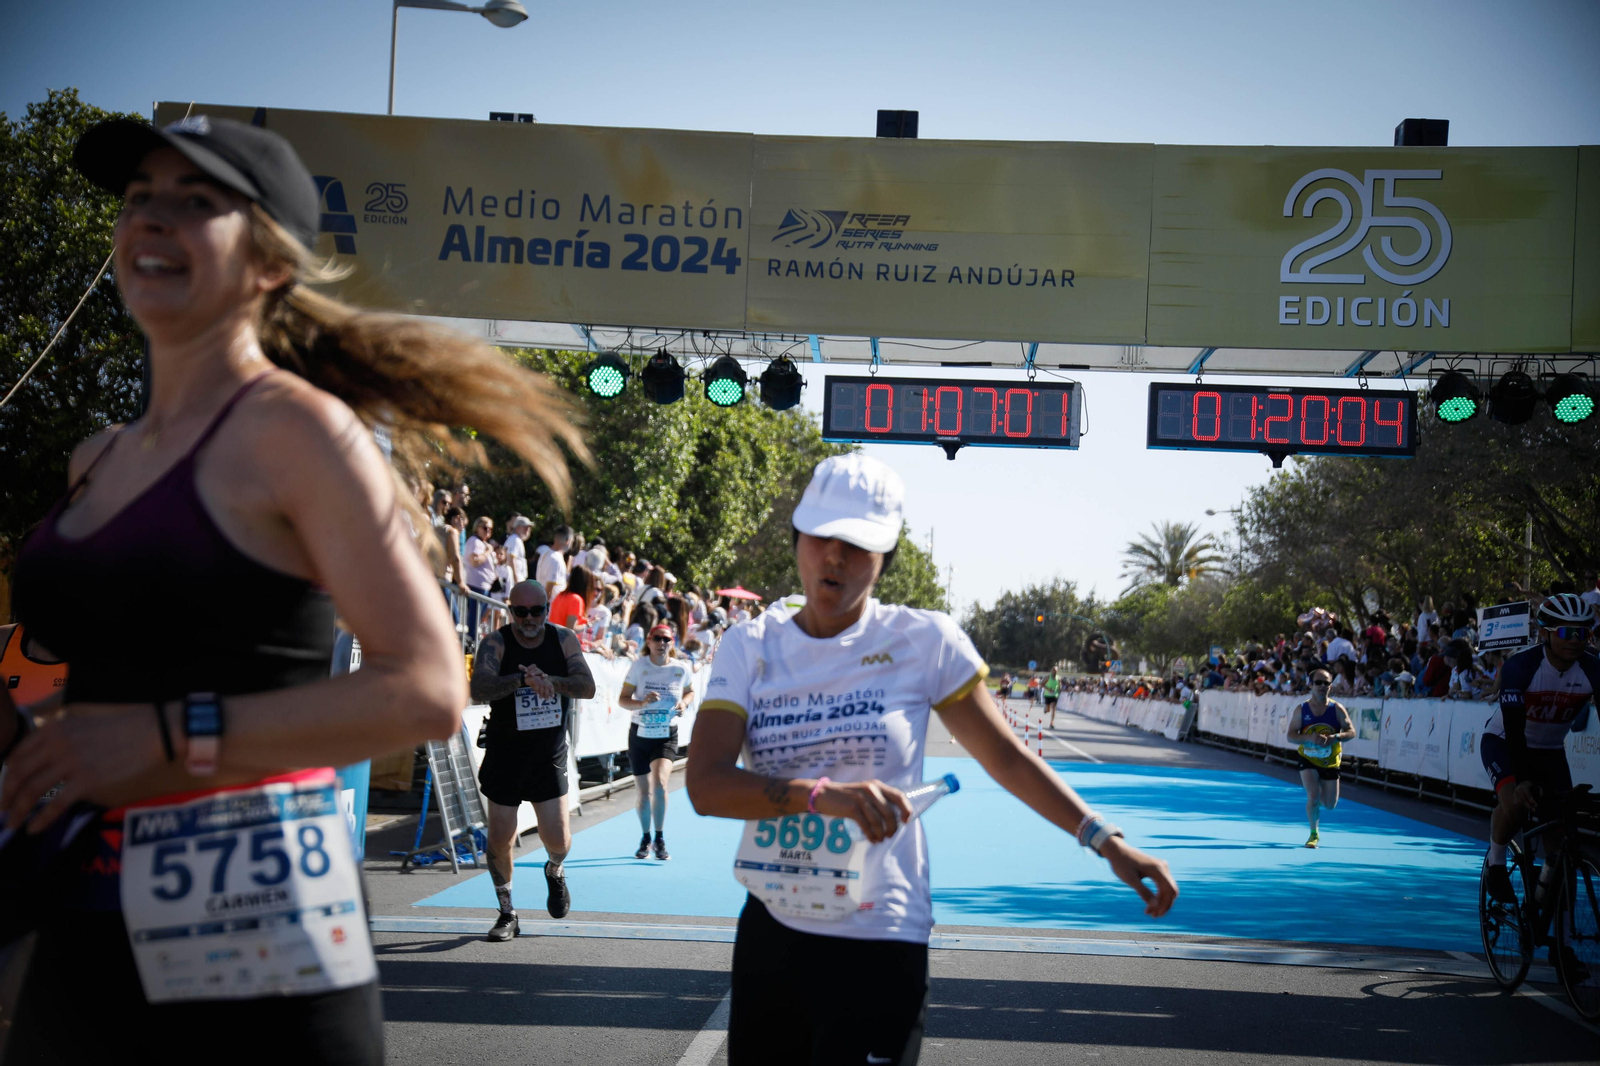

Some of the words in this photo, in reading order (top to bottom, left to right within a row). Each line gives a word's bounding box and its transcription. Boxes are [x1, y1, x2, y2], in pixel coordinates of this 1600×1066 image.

[364, 182, 408, 214] 25
[443, 186, 560, 221] Medio
[580, 193, 742, 230] Maratón
[363, 211, 408, 225] EDICIÓN
[847, 213, 911, 228] RFEA
[1280, 168, 1453, 286] 25
[438, 224, 611, 269] Almería
[620, 233, 741, 275] 2024
[835, 240, 875, 251] RUTA
[878, 241, 939, 252] RUNNING
[841, 228, 904, 240] SERIES
[767, 257, 864, 281] RAMÓN
[876, 263, 937, 283] RUIZ
[948, 263, 1076, 288] ANDÚJAR
[1278, 290, 1450, 328] EDICIÓN
[1192, 391, 1404, 446] 01:20:04
[1500, 622, 1524, 630] FEMENINA
[752, 693, 800, 711] Medio
[807, 688, 885, 706] Maratón
[751, 709, 822, 731] Almería
[827, 700, 885, 720] 2024
[791, 728, 820, 741] RUIZ
[825, 720, 887, 735] ANDÚJAR
[754, 813, 852, 854] 5698
[151, 824, 331, 902] 5758
[779, 848, 813, 861] MARTA
